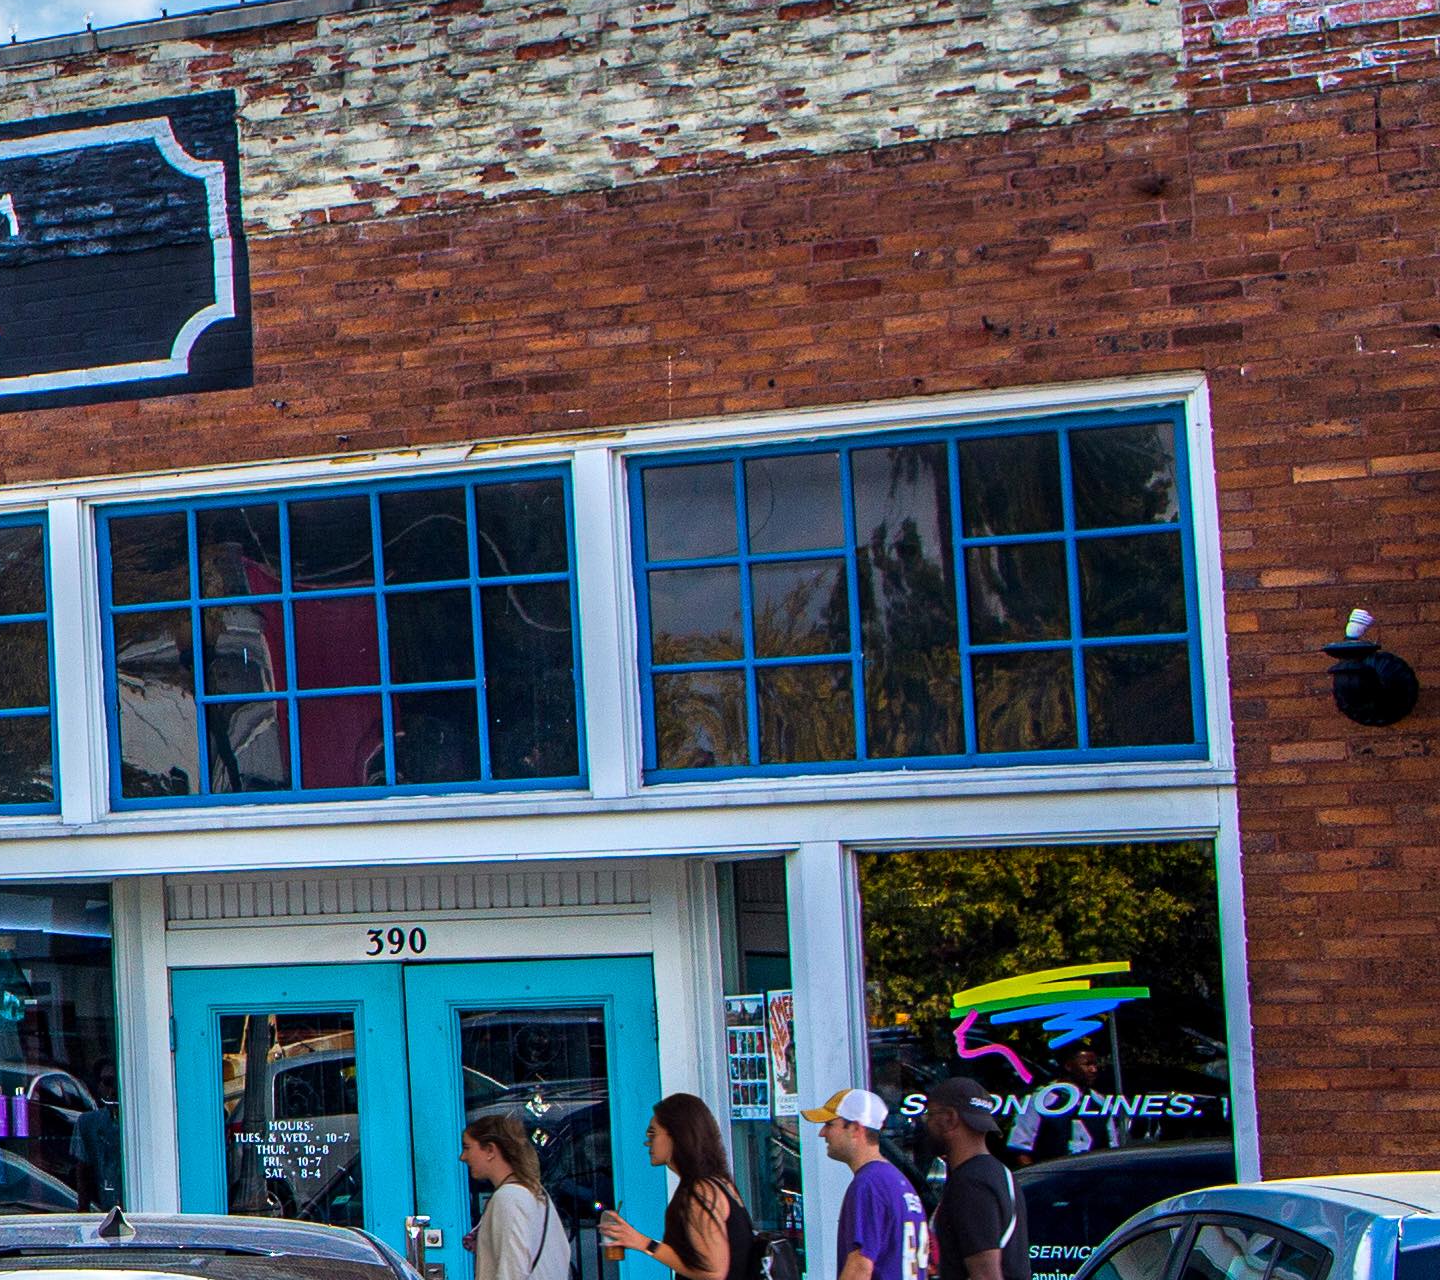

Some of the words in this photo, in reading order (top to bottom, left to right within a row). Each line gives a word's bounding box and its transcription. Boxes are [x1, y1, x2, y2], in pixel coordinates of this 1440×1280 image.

[366, 927, 427, 956] 390
[269, 1121, 314, 1132] HOURS:
[234, 1132, 264, 1143] TUES.
[268, 1132, 277, 1143] &
[281, 1132, 311, 1143] WED.
[325, 1132, 351, 1143] 10-7
[256, 1144, 289, 1155] THUR.
[304, 1144, 329, 1155] 10-8
[263, 1156, 283, 1167] FRI.
[297, 1156, 322, 1167] 10-7
[265, 1167, 287, 1179] SAT.
[301, 1168, 321, 1179] 8-4
